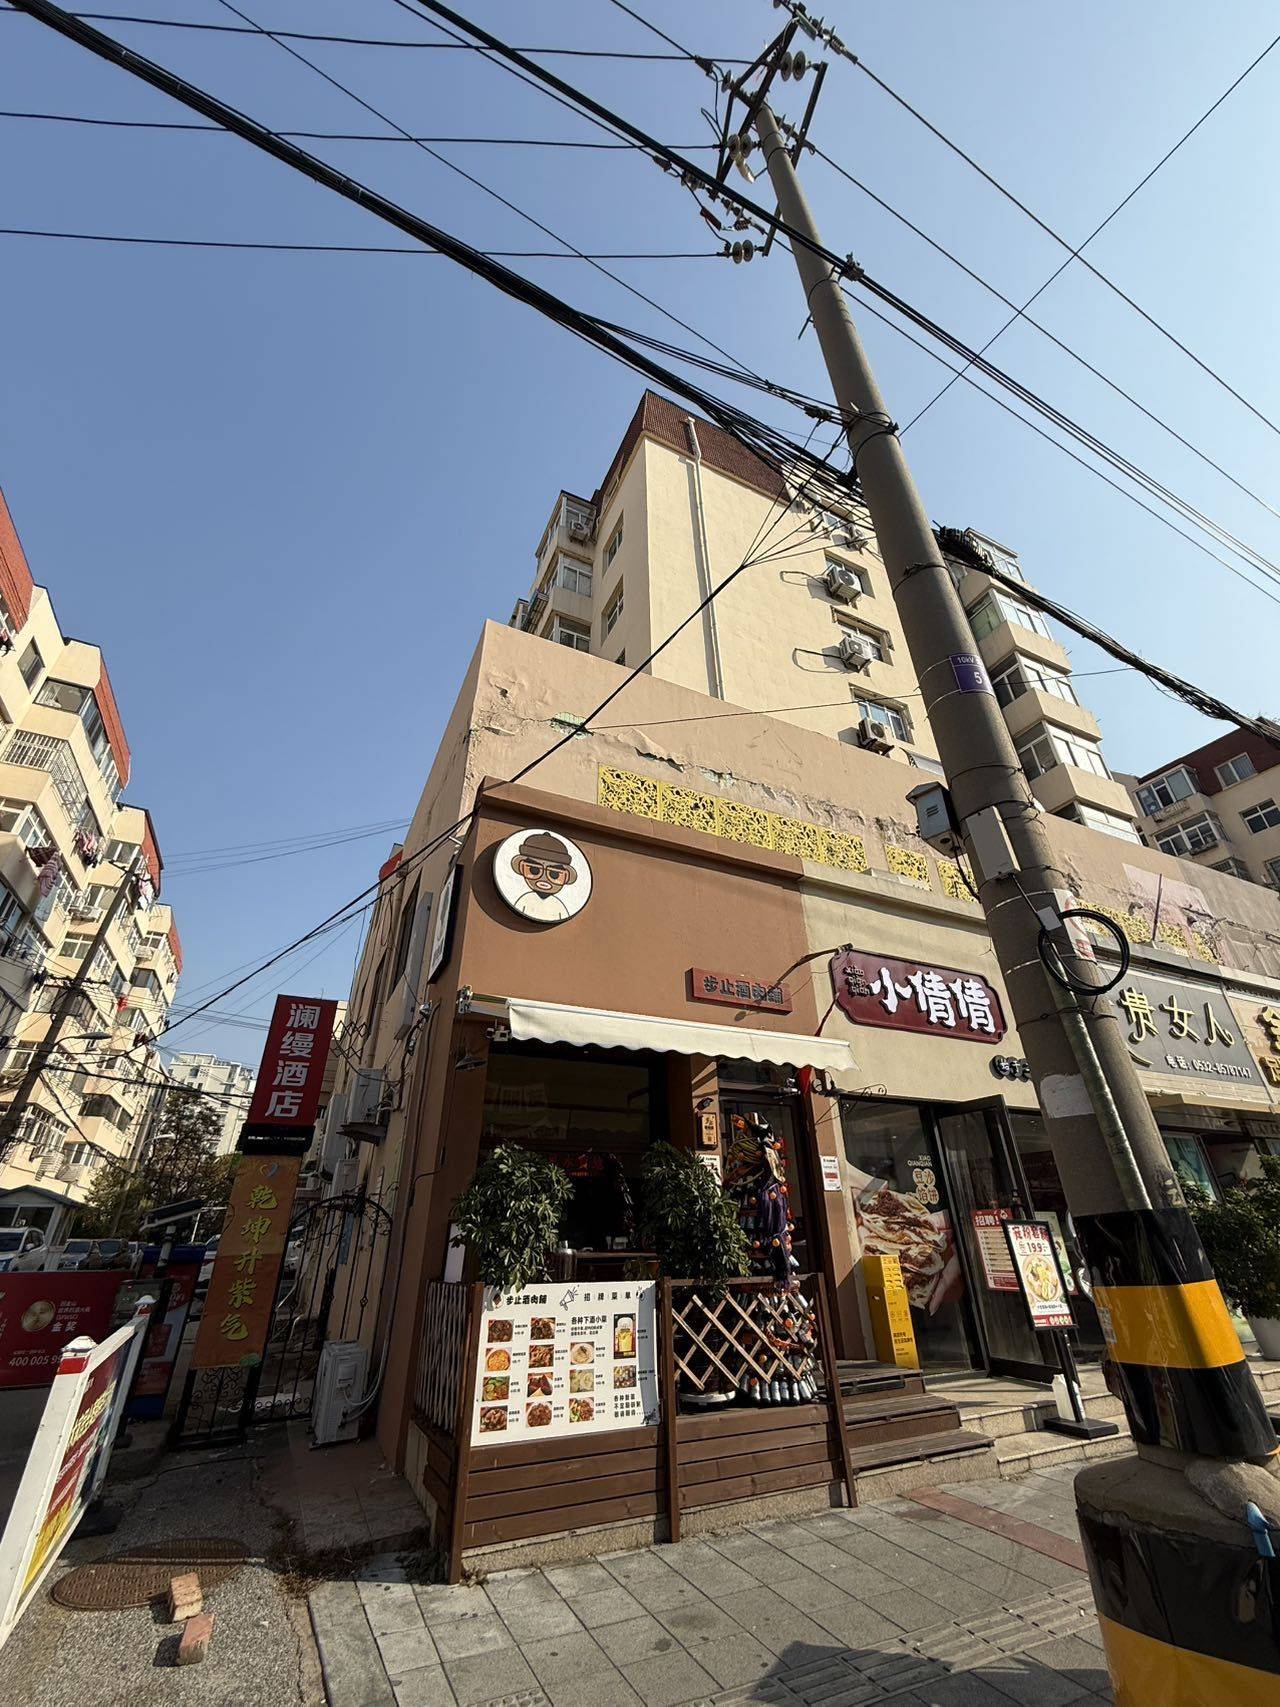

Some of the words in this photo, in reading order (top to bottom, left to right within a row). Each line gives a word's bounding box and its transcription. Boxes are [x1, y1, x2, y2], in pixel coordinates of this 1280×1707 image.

[973, 671, 983, 684] 5
[869, 966, 996, 1034] 小倩倩
[1111, 987, 1235, 1048] 贵女人
[265, 1003, 321, 1118] 澜缦酒店
[219, 1184, 279, 1341] 乾坤升紫气
[51, 1321, 77, 1332] 金奖
[8, 1357, 29, 1367] 400
[30, 1355, 49, 1366] 005
